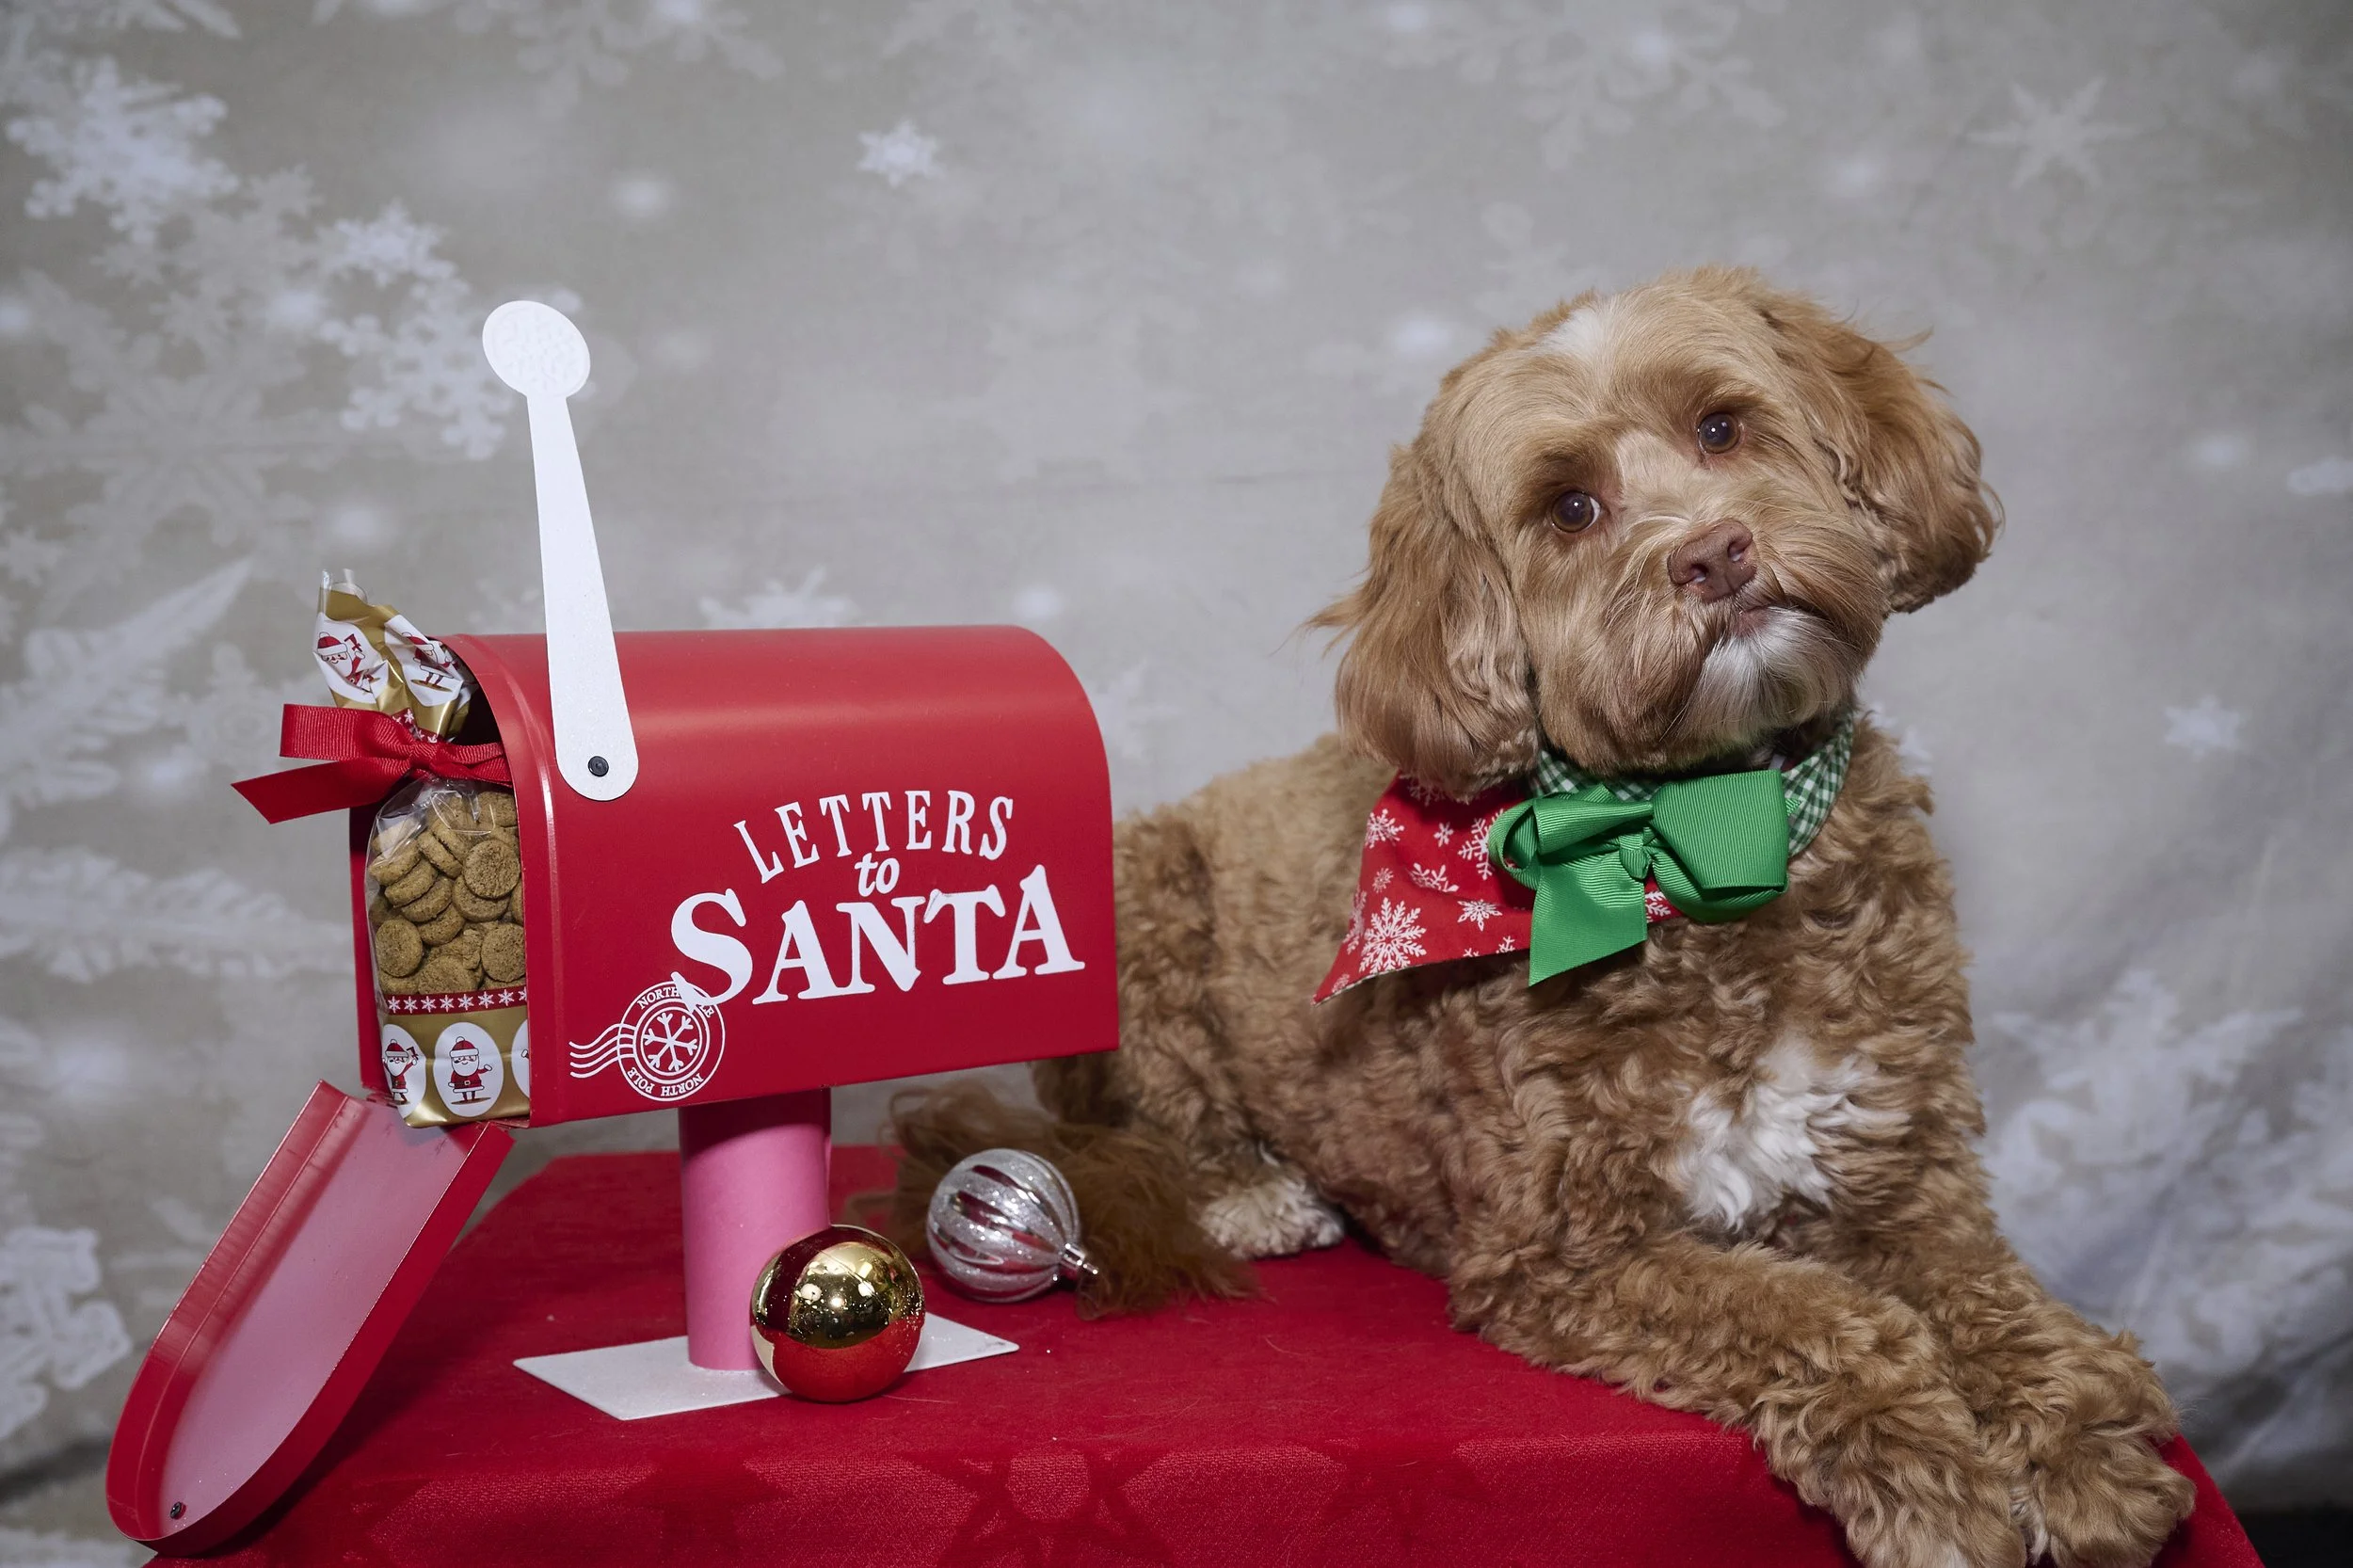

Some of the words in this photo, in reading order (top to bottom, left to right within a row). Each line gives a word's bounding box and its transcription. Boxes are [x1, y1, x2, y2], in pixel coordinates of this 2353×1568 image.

[733, 790, 1014, 883] LETTERS
[855, 852, 900, 897] to
[670, 864, 1086, 1014] SANTA
[636, 985, 680, 1010] NORTH
[626, 1066, 655, 1095] POLE
[660, 1072, 704, 1097] NORTH
